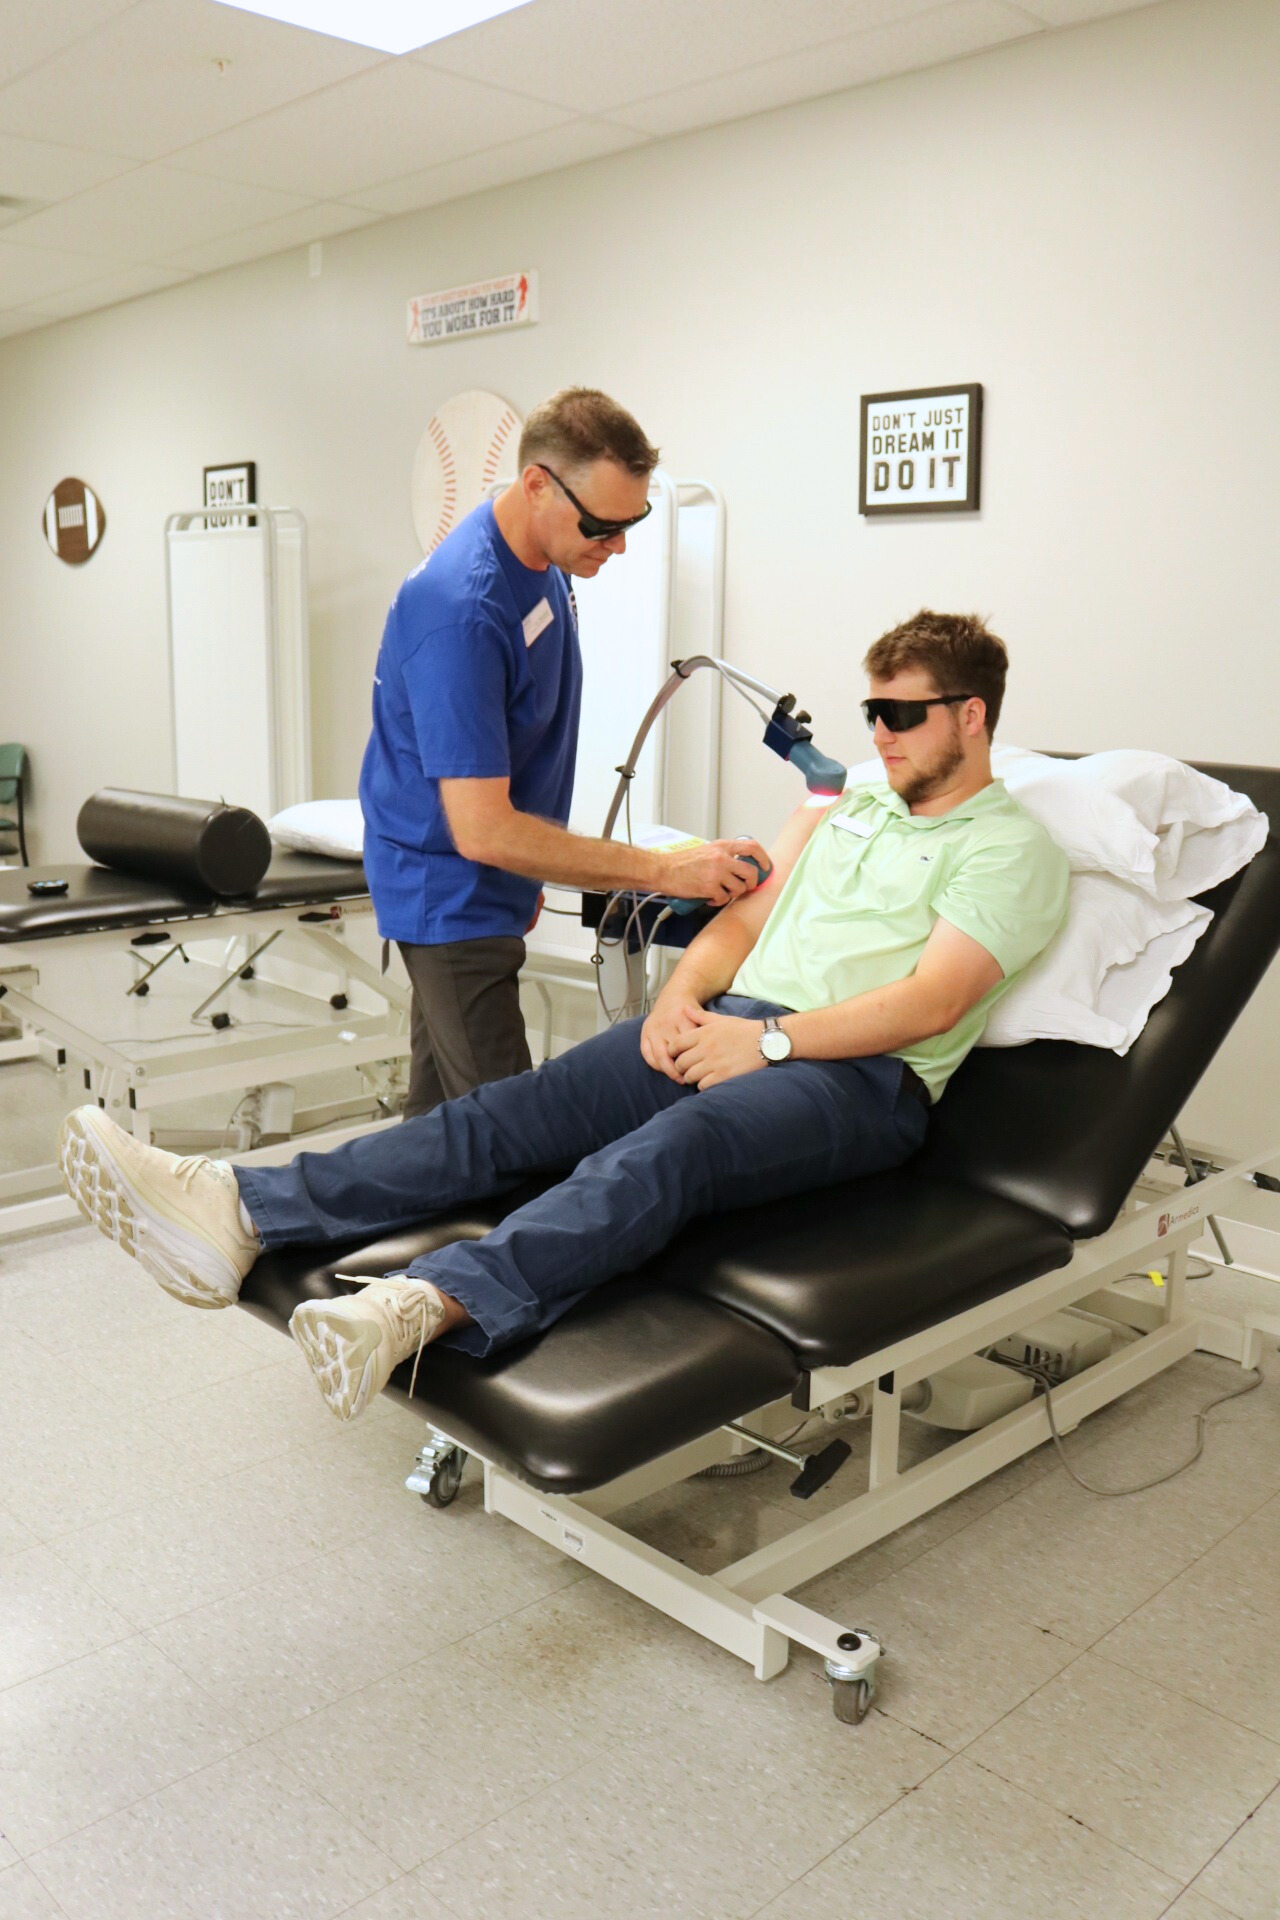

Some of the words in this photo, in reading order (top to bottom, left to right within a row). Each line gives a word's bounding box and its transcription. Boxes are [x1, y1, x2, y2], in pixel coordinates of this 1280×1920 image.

[421, 307, 436, 322] IT'S
[439, 300, 466, 317] ABOUT
[468, 295, 488, 311] HOW
[489, 289, 515, 306] HARD
[422, 321, 442, 338] YOU
[445, 312, 476, 334] WORK
[480, 308, 500, 326] FOR
[504, 304, 515, 322] IT
[872, 412, 916, 431] DON'T
[924, 407, 964, 427] JUST
[872, 431, 934, 455] DREAM
[945, 428, 963, 450] IT
[874, 459, 914, 492] DO
[929, 456, 961, 489] IT
[210, 478, 244, 500] DON'T
[1170, 1205, 1199, 1225] Armedica
